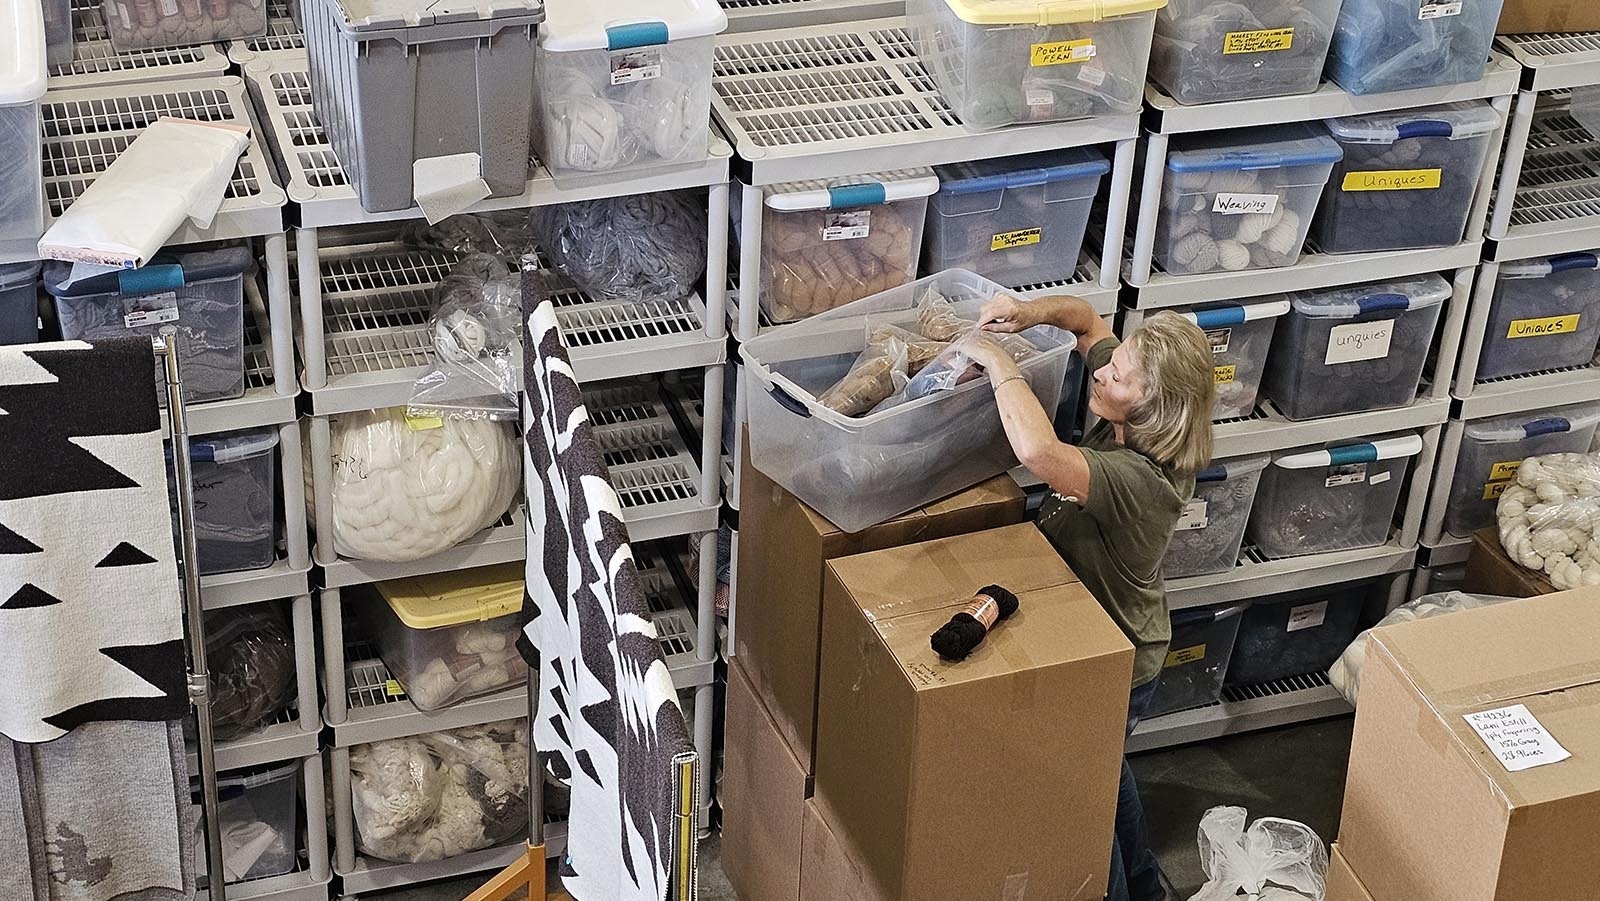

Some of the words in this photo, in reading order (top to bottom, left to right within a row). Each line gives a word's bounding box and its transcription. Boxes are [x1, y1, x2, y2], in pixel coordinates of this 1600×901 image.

[1035, 45, 1073, 56] POWELL
[1043, 53, 1070, 63] FERN
[1364, 174, 1426, 188] Uniques
[1218, 197, 1266, 212] Weaving
